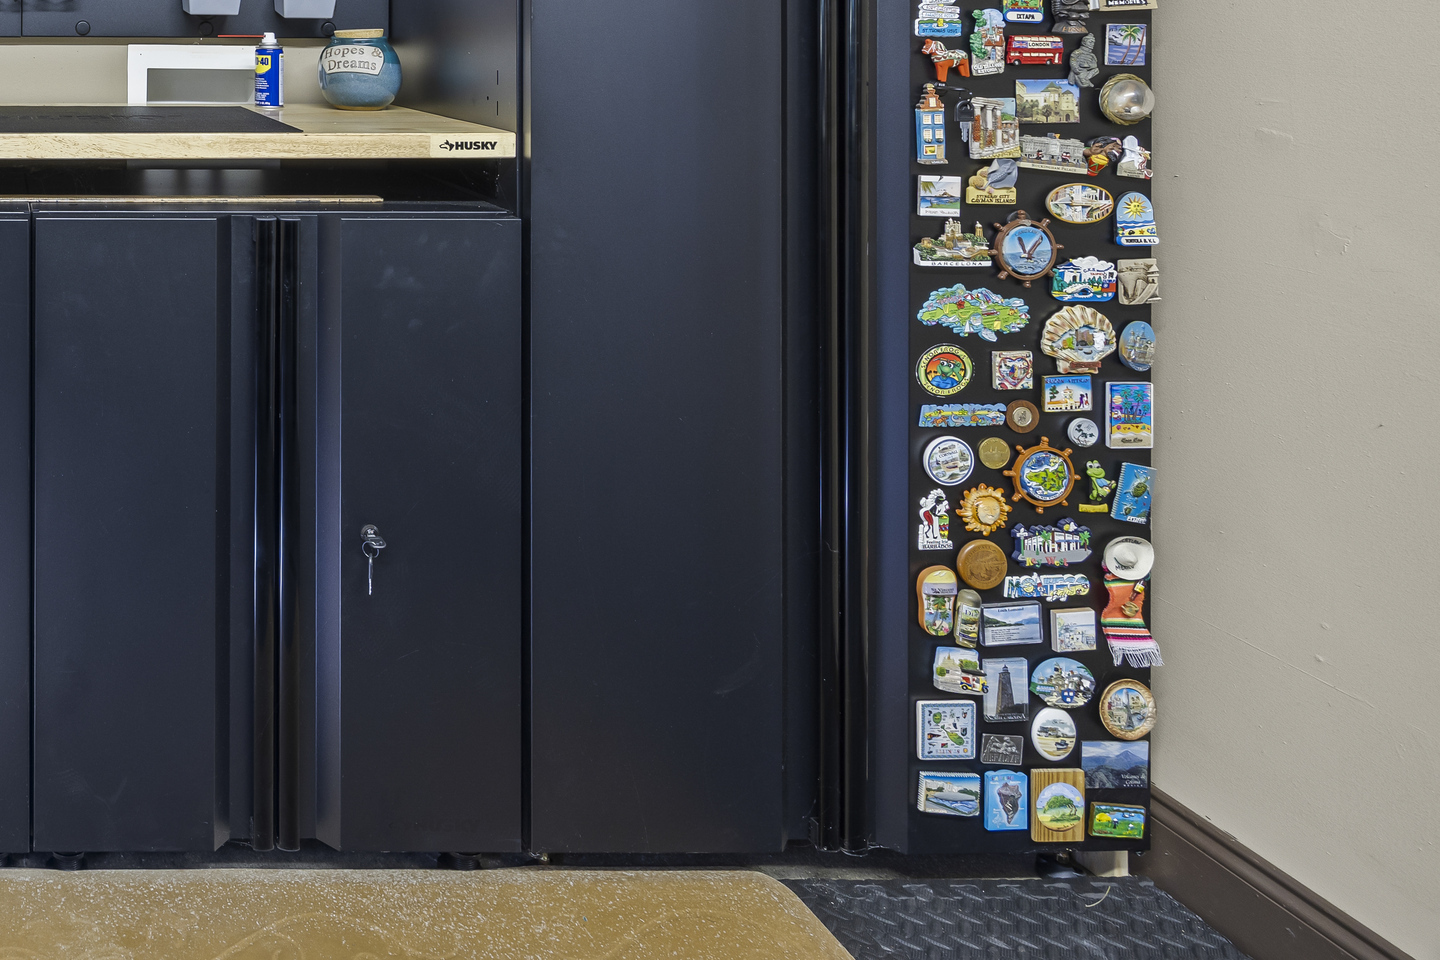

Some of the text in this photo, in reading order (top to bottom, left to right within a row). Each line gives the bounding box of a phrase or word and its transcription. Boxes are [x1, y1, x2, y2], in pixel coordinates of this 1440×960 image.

[324, 46, 383, 59] Hopes &
[327, 59, 377, 72] Dreams
[455, 141, 498, 151] HUSKY
[1025, 556, 1069, 568] Key West
